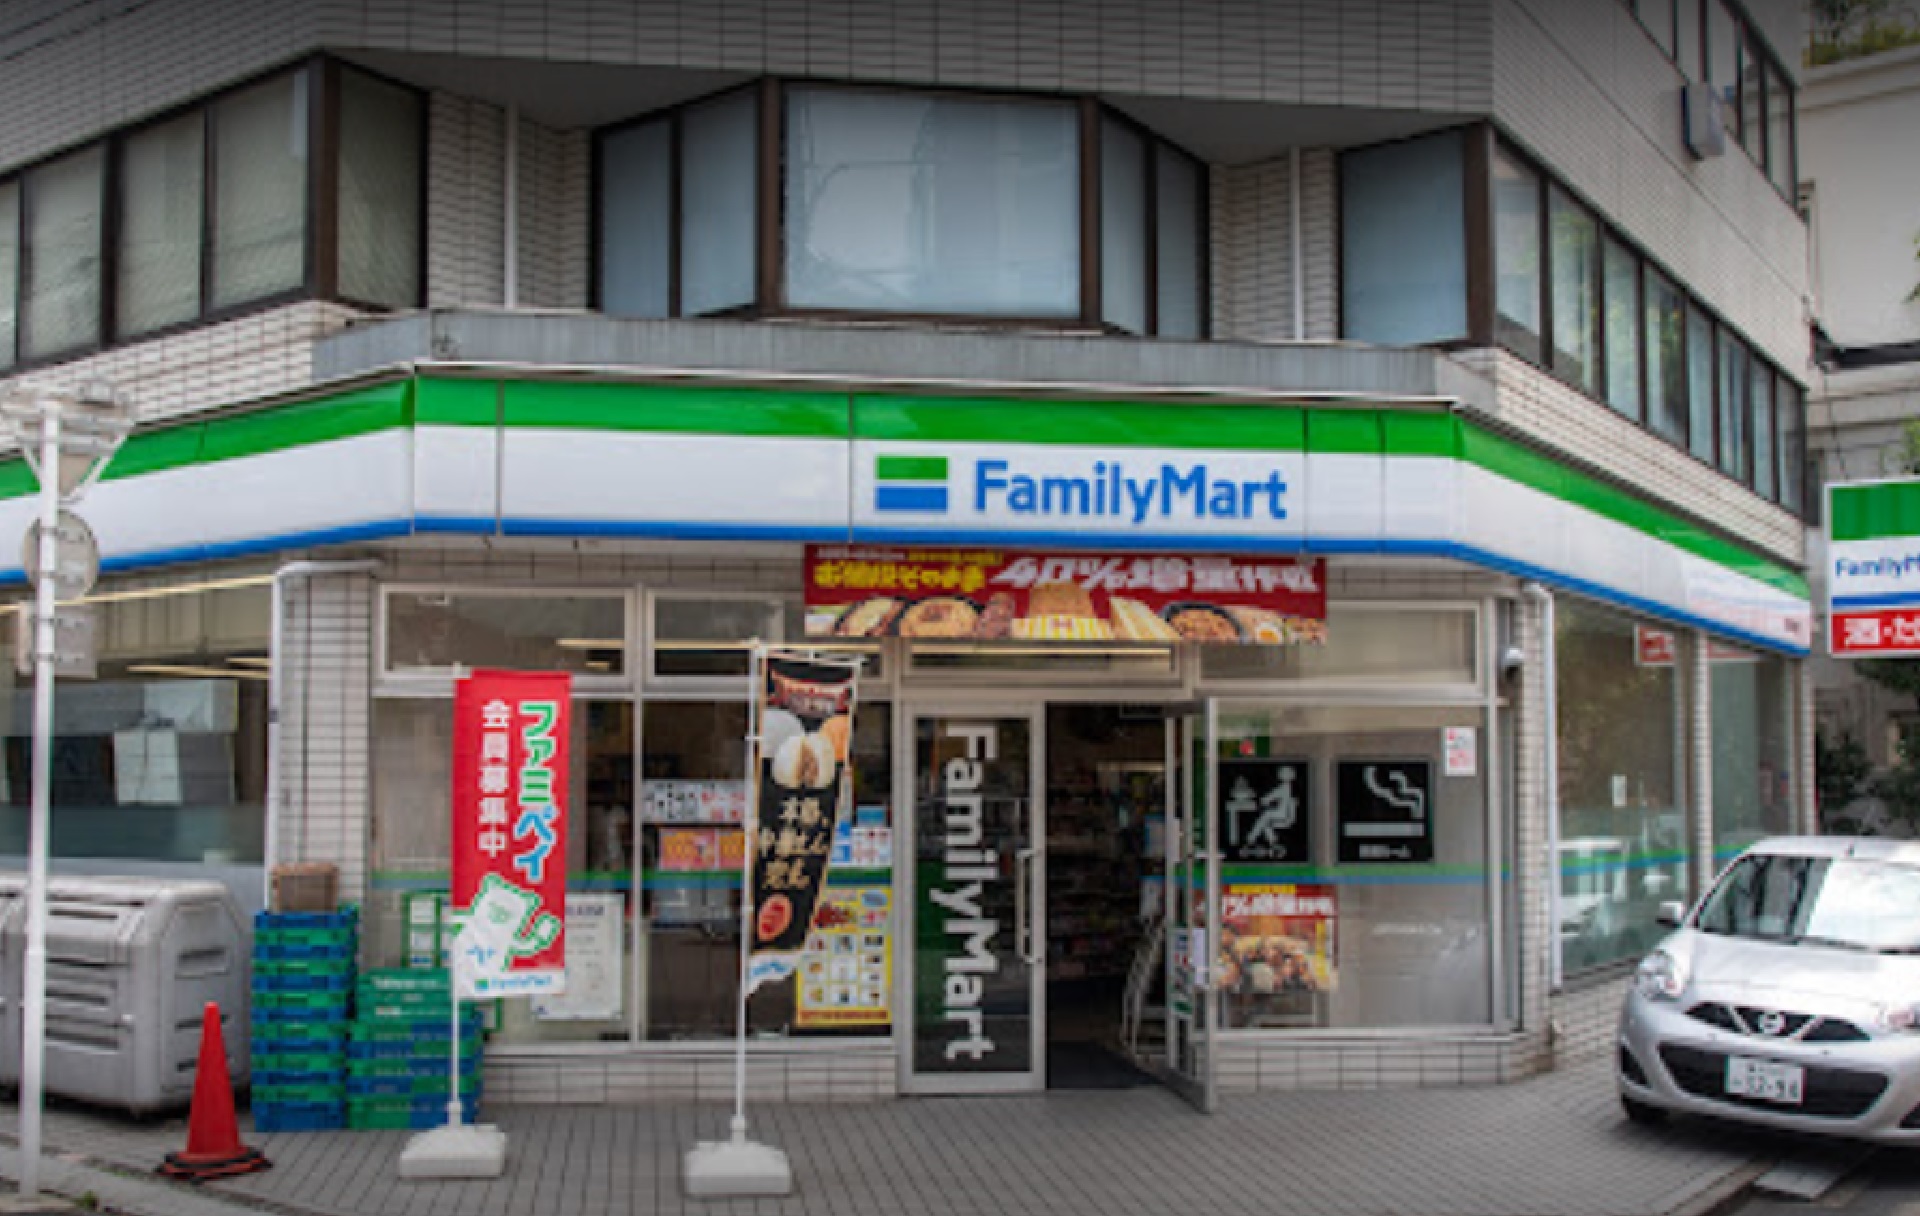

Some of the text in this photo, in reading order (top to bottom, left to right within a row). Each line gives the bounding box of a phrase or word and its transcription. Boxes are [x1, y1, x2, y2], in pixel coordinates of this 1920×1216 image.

[976, 460, 1288, 524] FamilyMart
[478, 699, 511, 858] 会員募集中
[514, 700, 559, 883] ファミペイ
[929, 723, 1000, 1061] FamilyMart
